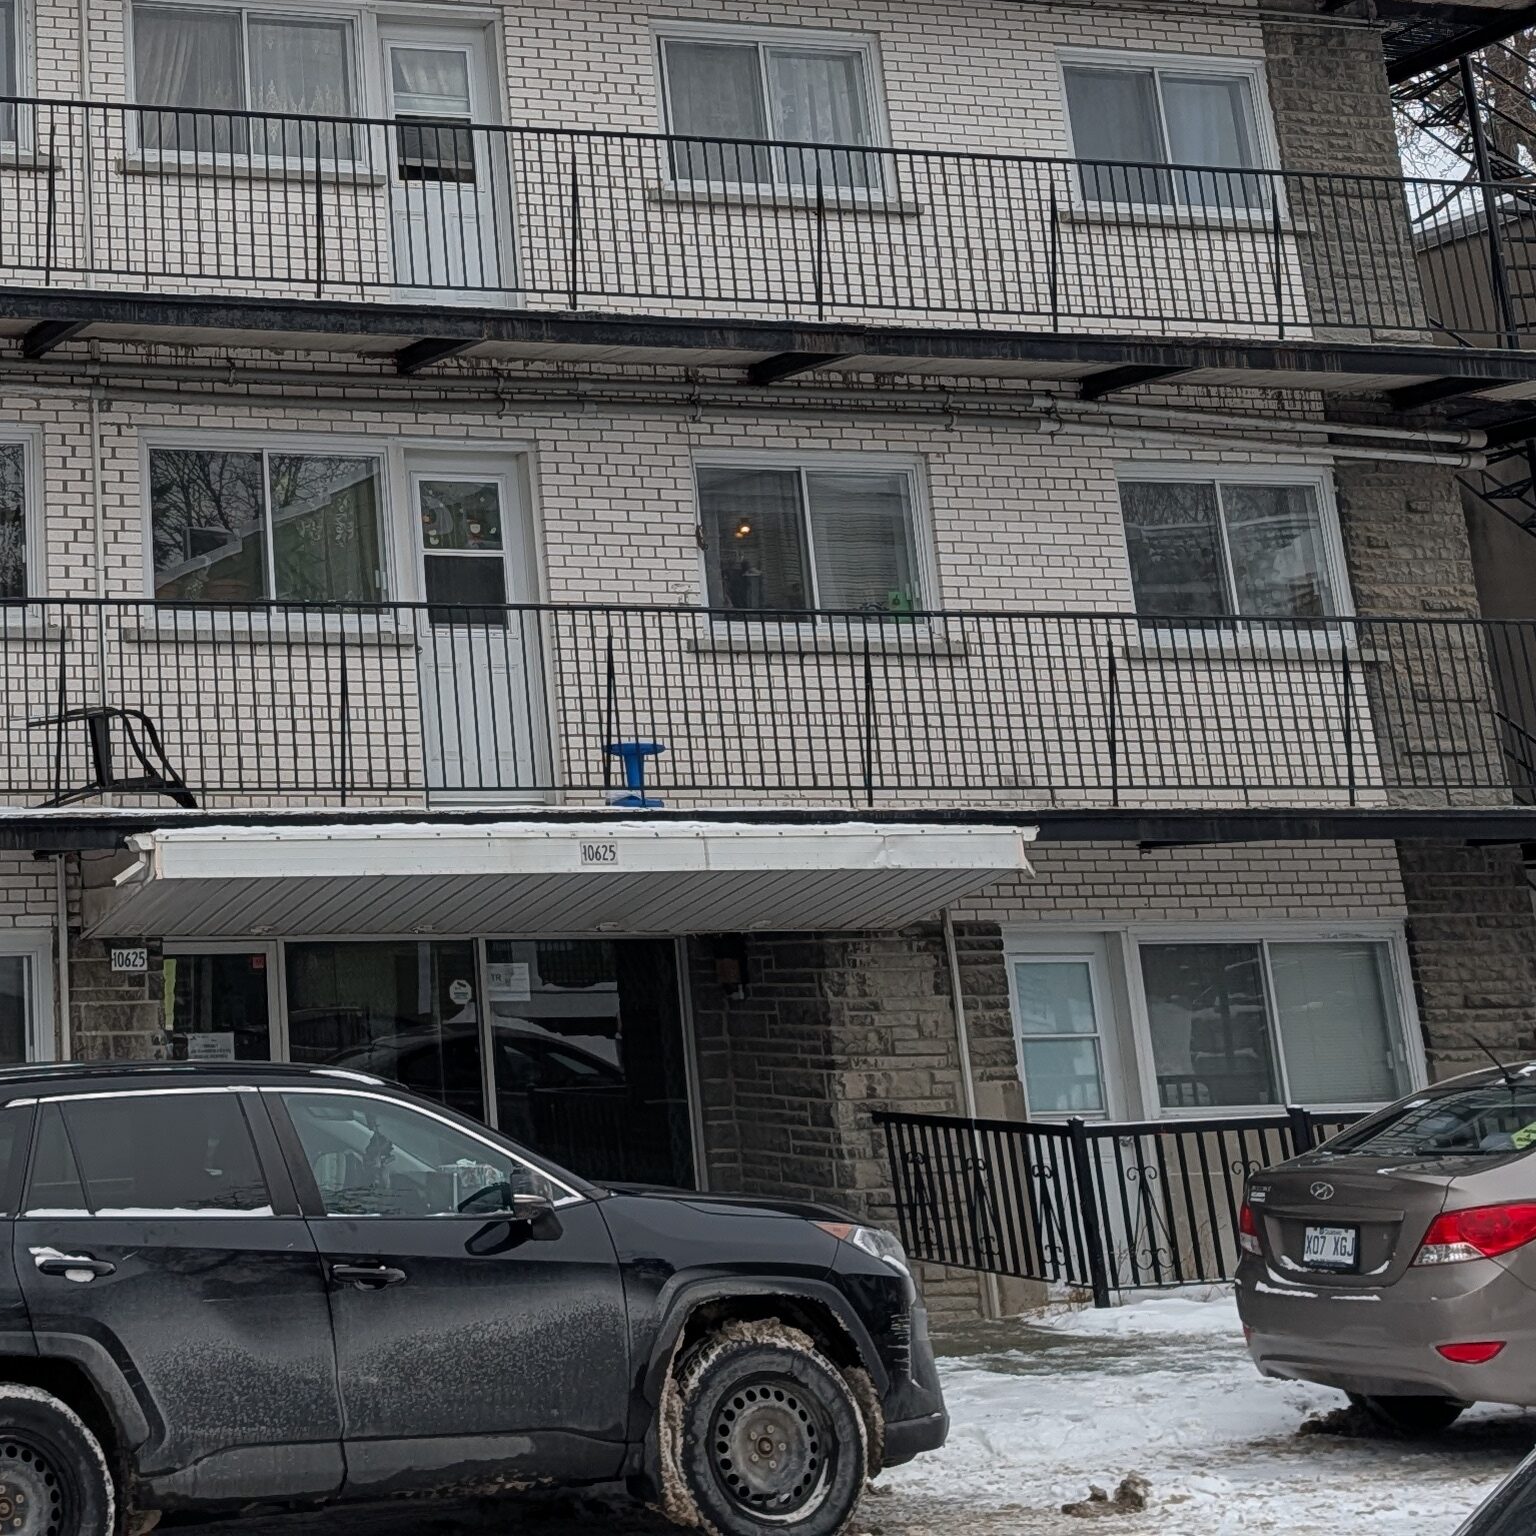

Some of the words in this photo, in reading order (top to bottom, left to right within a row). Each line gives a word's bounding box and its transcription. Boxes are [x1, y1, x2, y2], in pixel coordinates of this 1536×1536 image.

[582, 844, 616, 862] 10625
[113, 950, 146, 968] 10625
[1305, 1234, 1327, 1255] X07
[1332, 1236, 1355, 1257] XGJ
